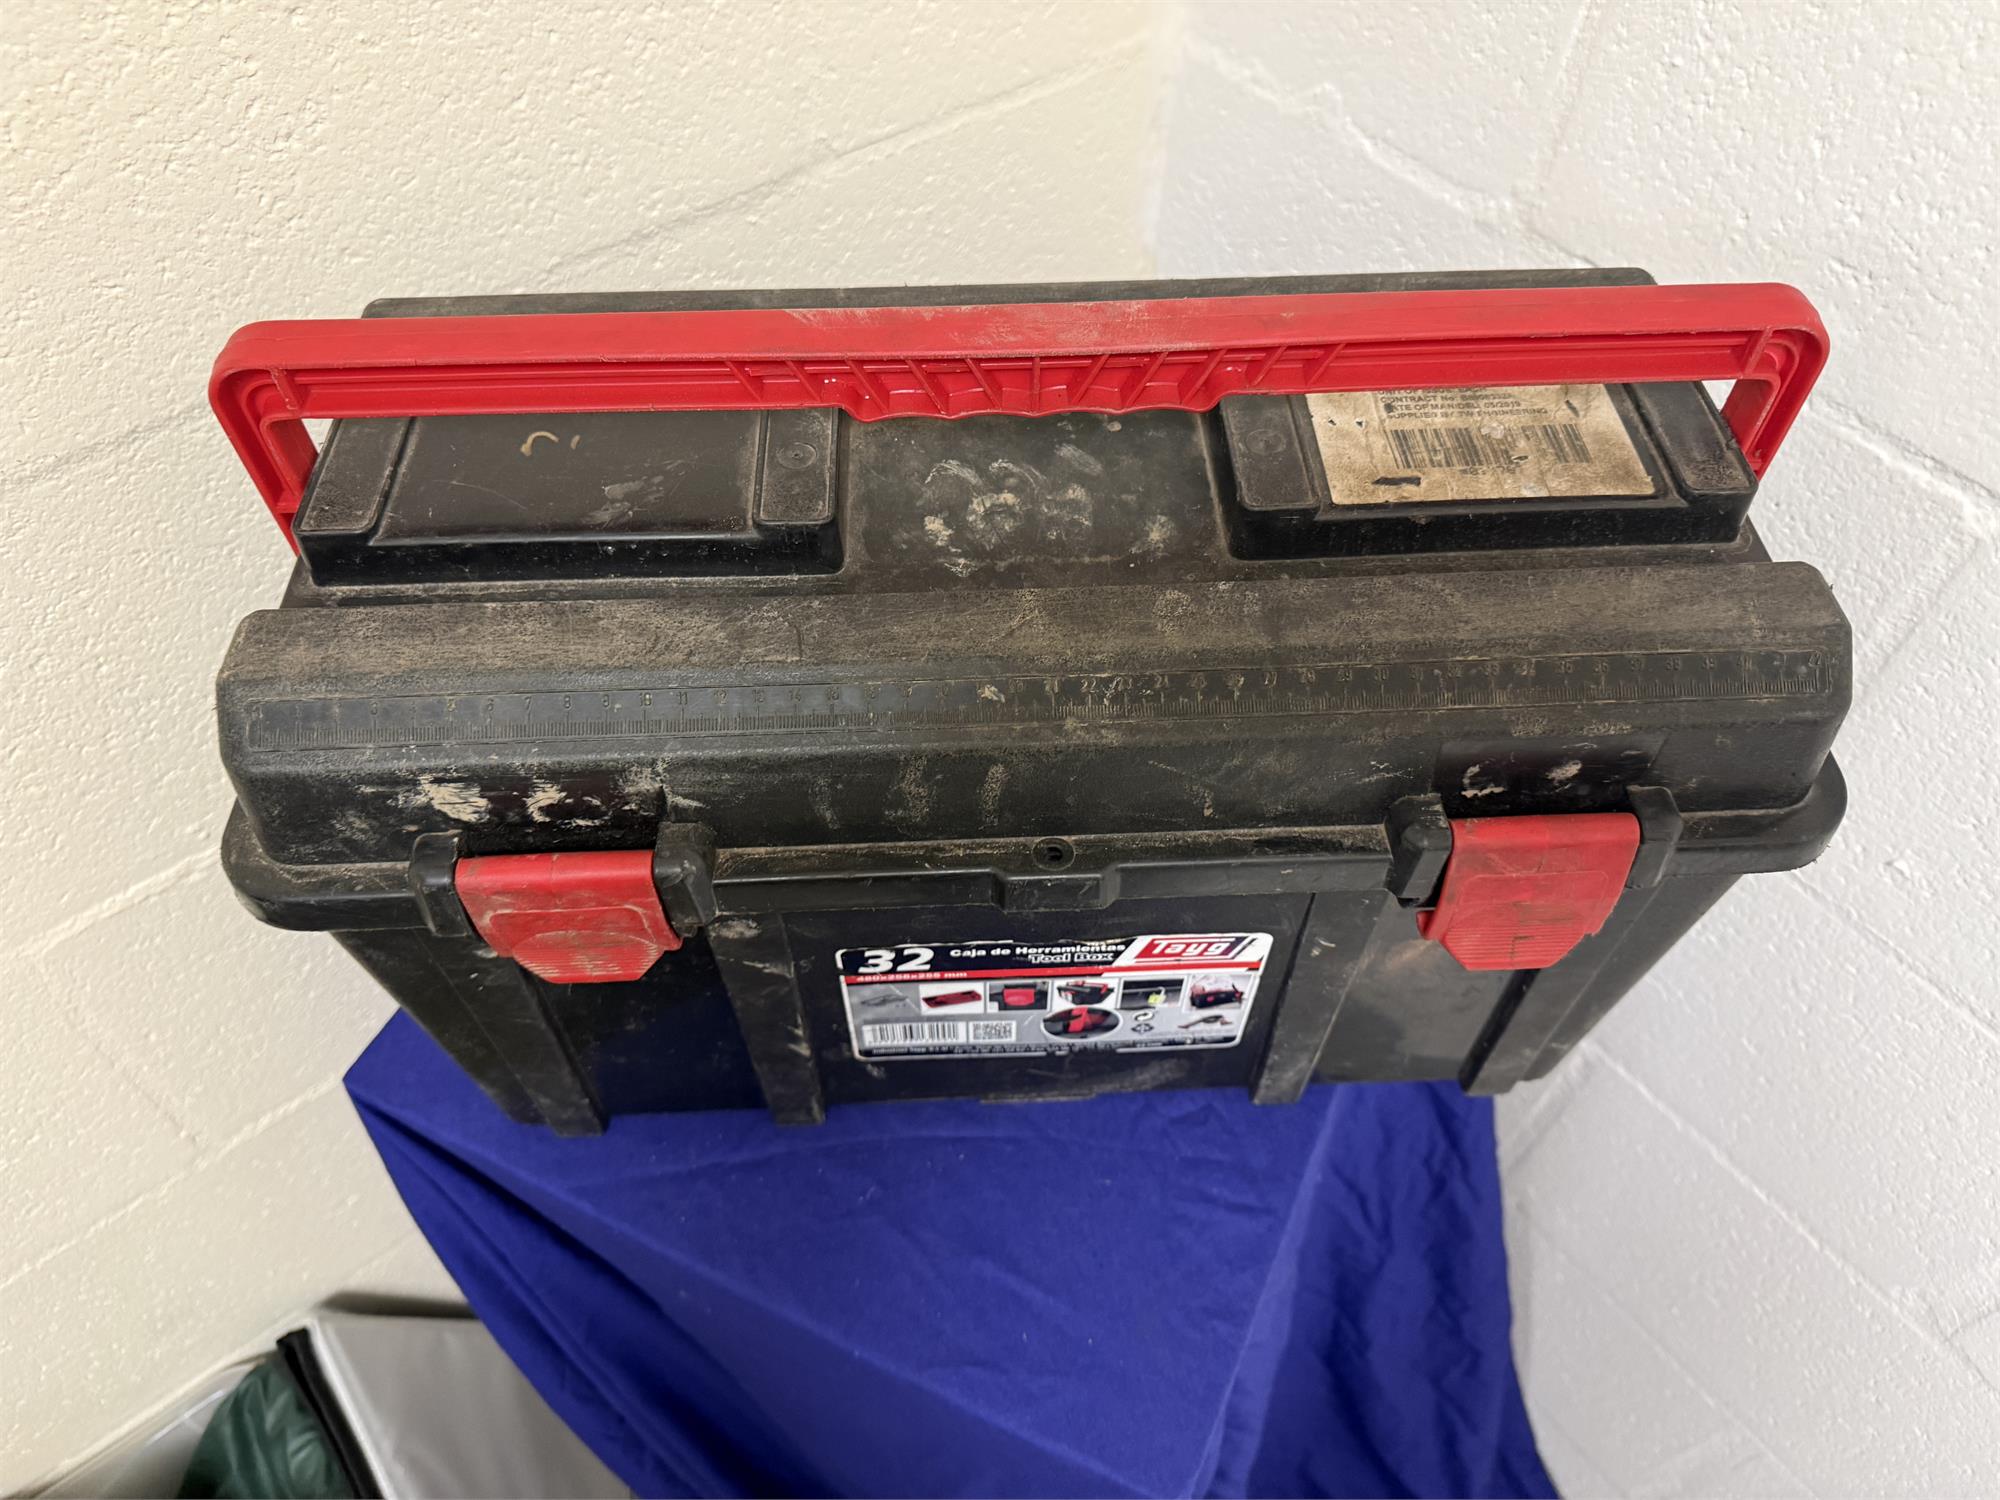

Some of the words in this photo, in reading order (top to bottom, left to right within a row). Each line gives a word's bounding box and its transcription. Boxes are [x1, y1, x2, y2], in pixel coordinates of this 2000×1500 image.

[1380, 395, 1438, 404] CONTRACT
[1384, 402, 1412, 413] ATE
[1414, 403, 1428, 411] OF
[1151, 938, 1234, 956] Tayg
[857, 947, 934, 974] 32
[949, 948, 986, 959] Caja
[990, 947, 1011, 957] de
[1015, 943, 1126, 956] Herramientas
[1029, 952, 1071, 964] Tool
[1074, 951, 1114, 963] Box
[944, 971, 968, 979] mm
